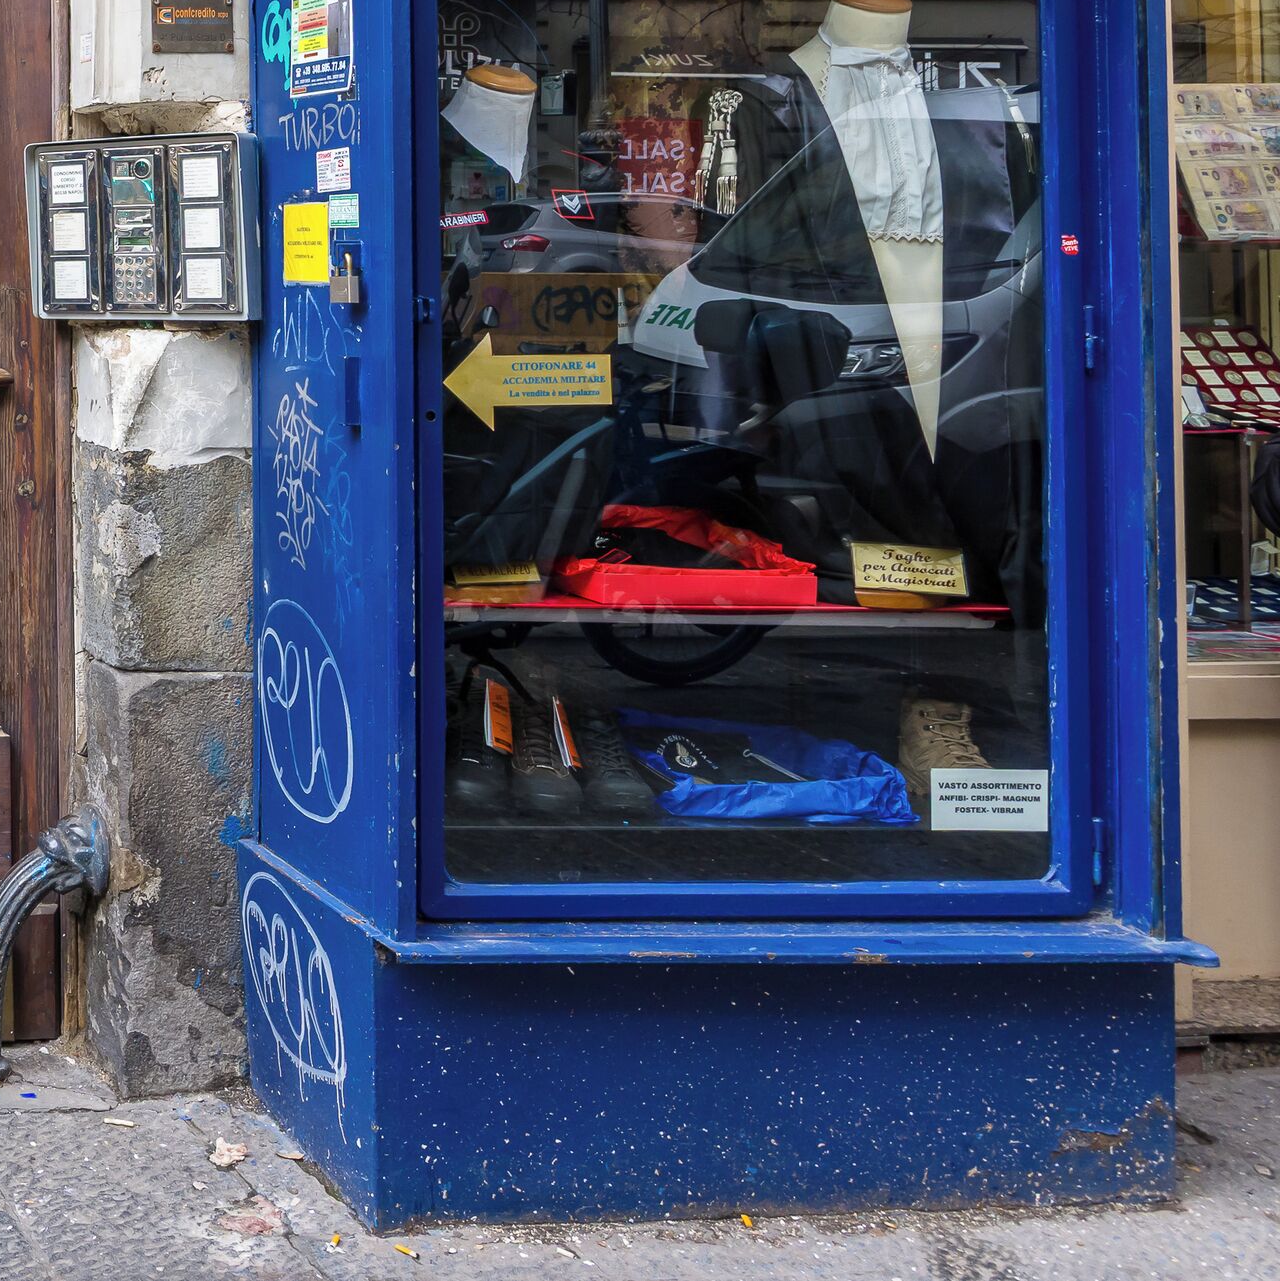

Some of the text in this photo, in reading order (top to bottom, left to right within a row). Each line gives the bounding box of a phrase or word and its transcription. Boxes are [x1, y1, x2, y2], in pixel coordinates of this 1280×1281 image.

[176, 7, 216, 18] confcredito
[511, 361, 596, 371] CITOFONARE 44
[502, 375, 606, 385] ACCADEMIA MILITARE
[509, 390, 520, 398] La
[521, 389, 550, 397] vendita
[558, 389, 570, 397] nel
[571, 389, 601, 398] palazzo
[881, 548, 933, 565] Toghe
[863, 563, 956, 576] per Avvocati
[863, 573, 957, 588] e Magistrati
[938, 782, 1042, 790] VASTO ASSORTIMENTO
[954, 806, 989, 814] FOSTEX-
